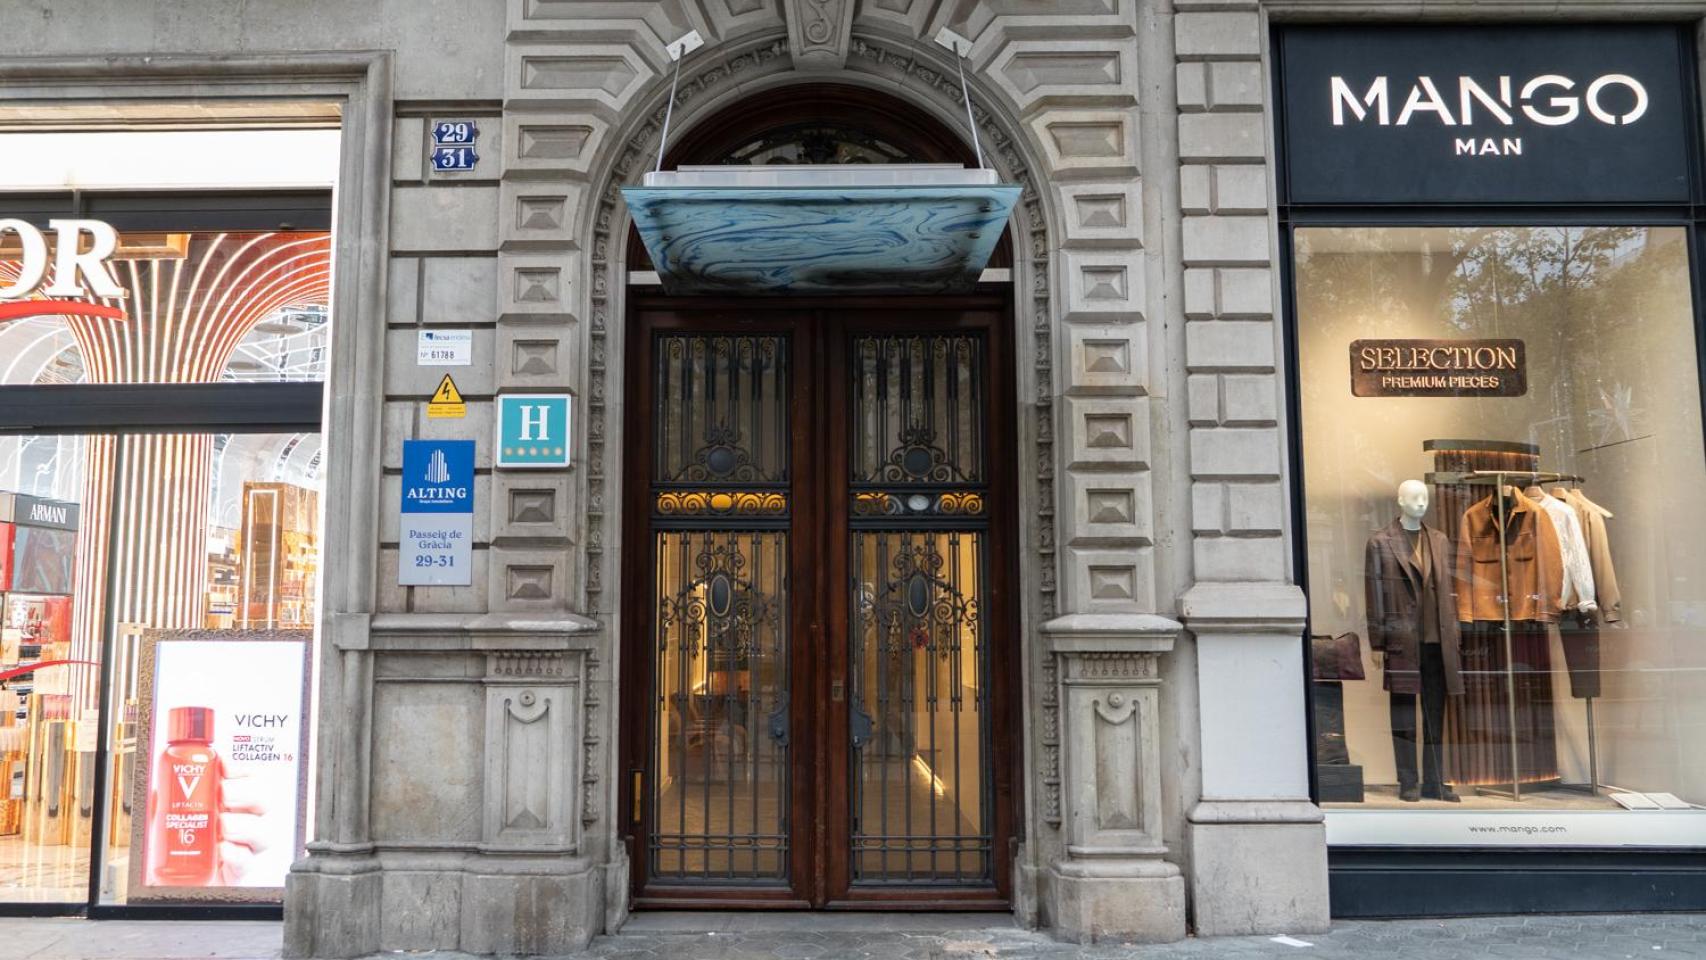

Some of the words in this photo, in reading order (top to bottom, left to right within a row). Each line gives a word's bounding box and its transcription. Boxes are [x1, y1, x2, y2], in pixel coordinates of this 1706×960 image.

[1330, 74, 1649, 126] MANGO
[440, 123, 468, 142] 29
[1455, 138, 1522, 156] MAN
[441, 149, 467, 167] 31
[431, 350, 455, 359] 61788
[1360, 347, 1517, 371] SELECTION
[1382, 376, 1447, 389] PREMIUM
[1449, 376, 1500, 389] PIECES
[518, 405, 550, 441] H
[407, 487, 467, 499] ALTING
[30, 503, 67, 524] ARMANI
[409, 529, 447, 540] Passeig
[449, 529, 463, 539] de
[415, 555, 455, 567] 29-31
[234, 714, 288, 728] VICHY
[232, 744, 274, 752] LIFTACTIV
[232, 752, 281, 761] COLLAGEN
[283, 753, 294, 762] 16
[173, 764, 207, 774] VICHY
[166, 820, 208, 829] SPECIALIST
[1468, 825, 1567, 835] www.mango.com
[180, 828, 196, 845] 16
